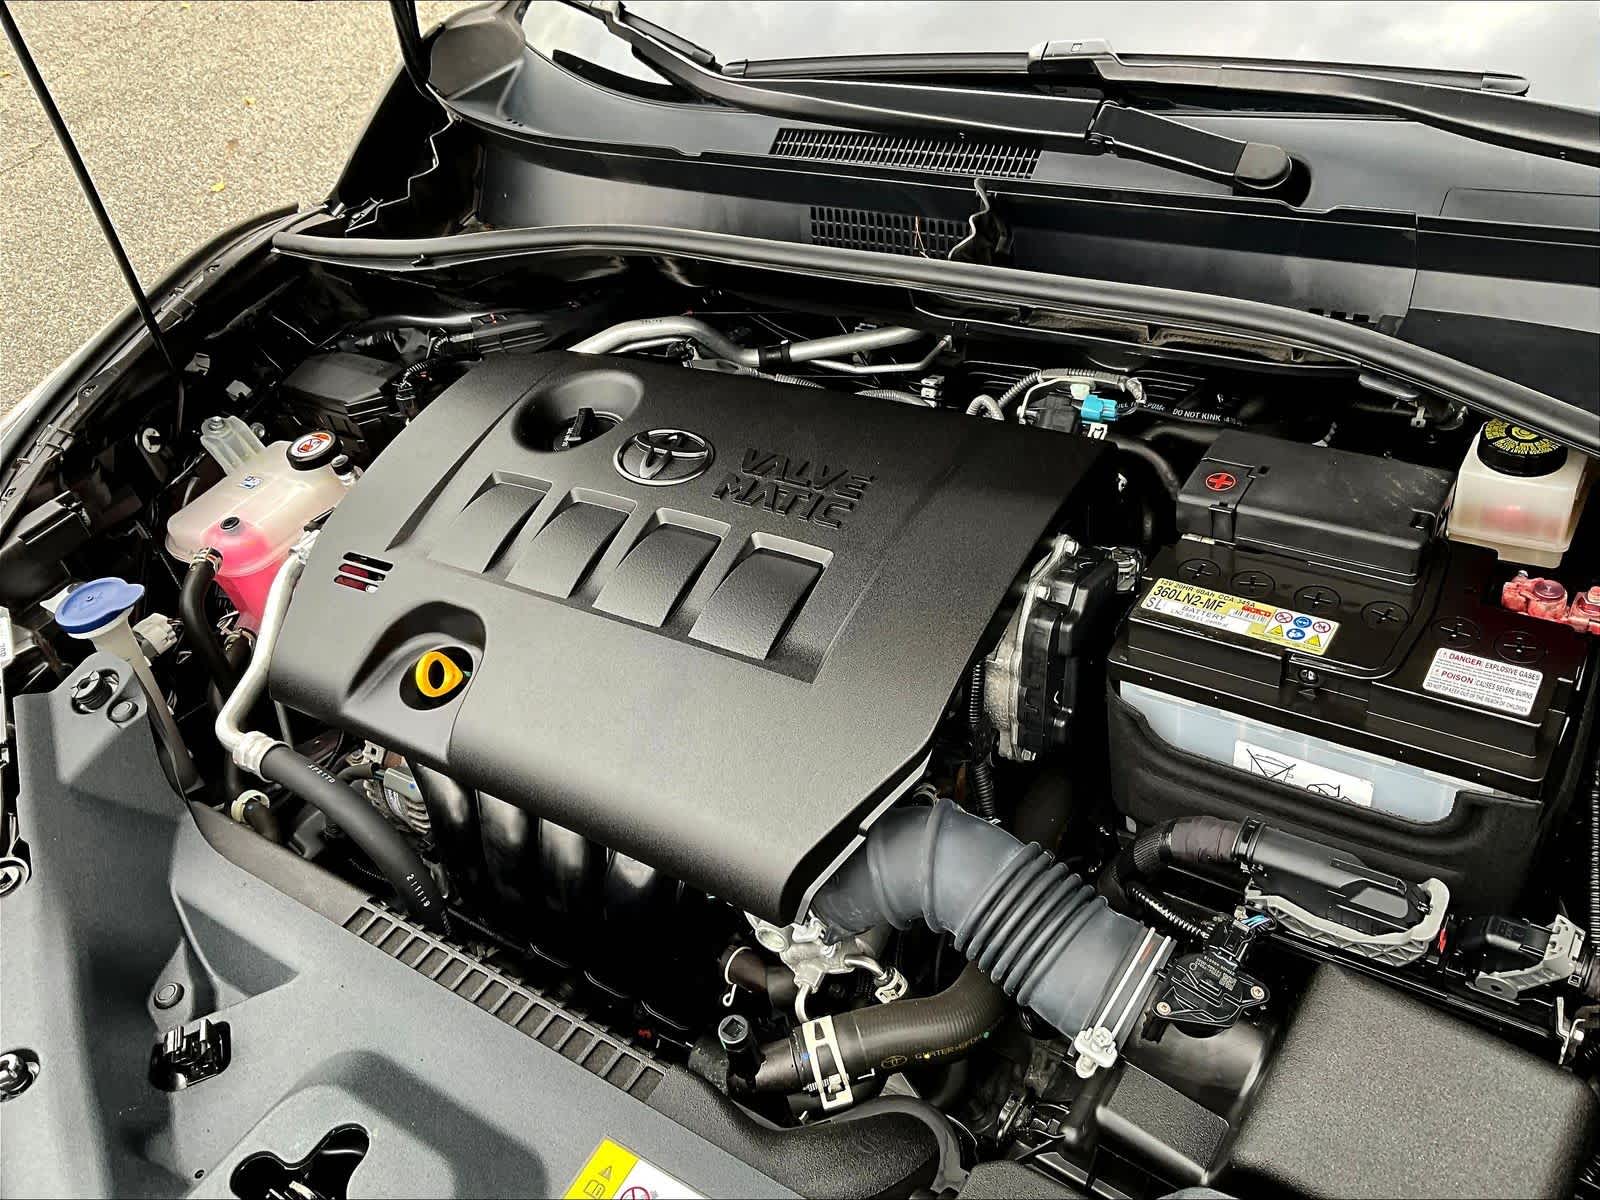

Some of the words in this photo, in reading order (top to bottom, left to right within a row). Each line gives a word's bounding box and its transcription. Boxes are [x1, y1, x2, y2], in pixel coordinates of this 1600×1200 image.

[1172, 408, 1183, 416] DO
[1184, 409, 1200, 420] NOT
[1201, 411, 1221, 422] KINK
[741, 448, 875, 501] VALVE
[711, 472, 855, 529] MATIC
[1145, 597, 1162, 611] SL
[1153, 585, 1226, 611] 360LN2-MF
[1181, 606, 1226, 621] BATTERY
[1448, 653, 1482, 667] DANGER
[1485, 663, 1518, 676] EXPLOSIVE
[1519, 671, 1540, 681] GASES
[1441, 670, 1475, 684] POISON
[1496, 684, 1516, 695] SEVERE
